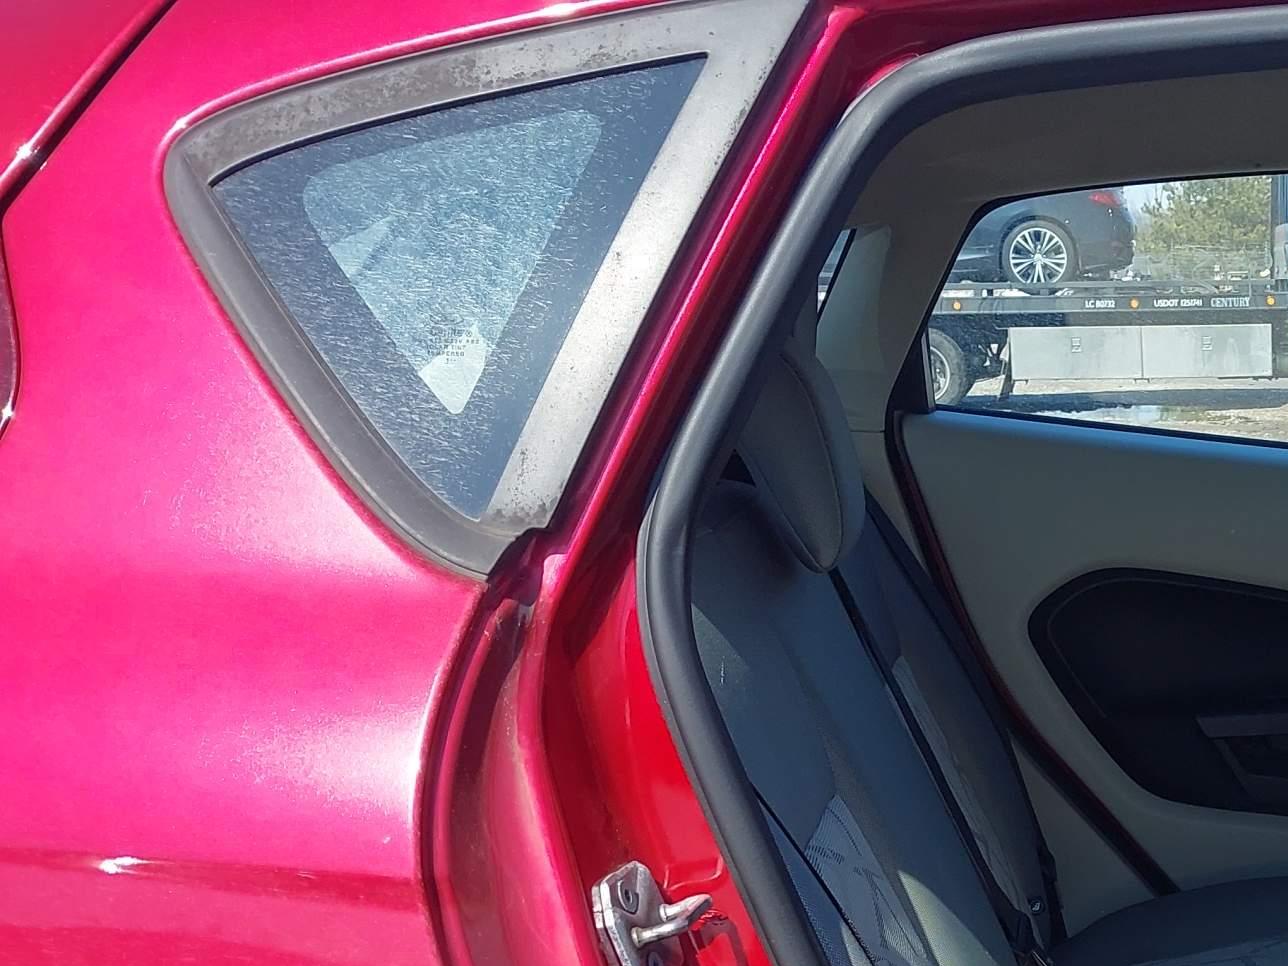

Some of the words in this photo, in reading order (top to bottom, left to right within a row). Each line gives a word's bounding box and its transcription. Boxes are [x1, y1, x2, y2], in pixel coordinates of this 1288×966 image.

[1085, 300, 1095, 308] LC
[1153, 299, 1179, 308] USDOT
[1210, 296, 1250, 308] CENTURY
